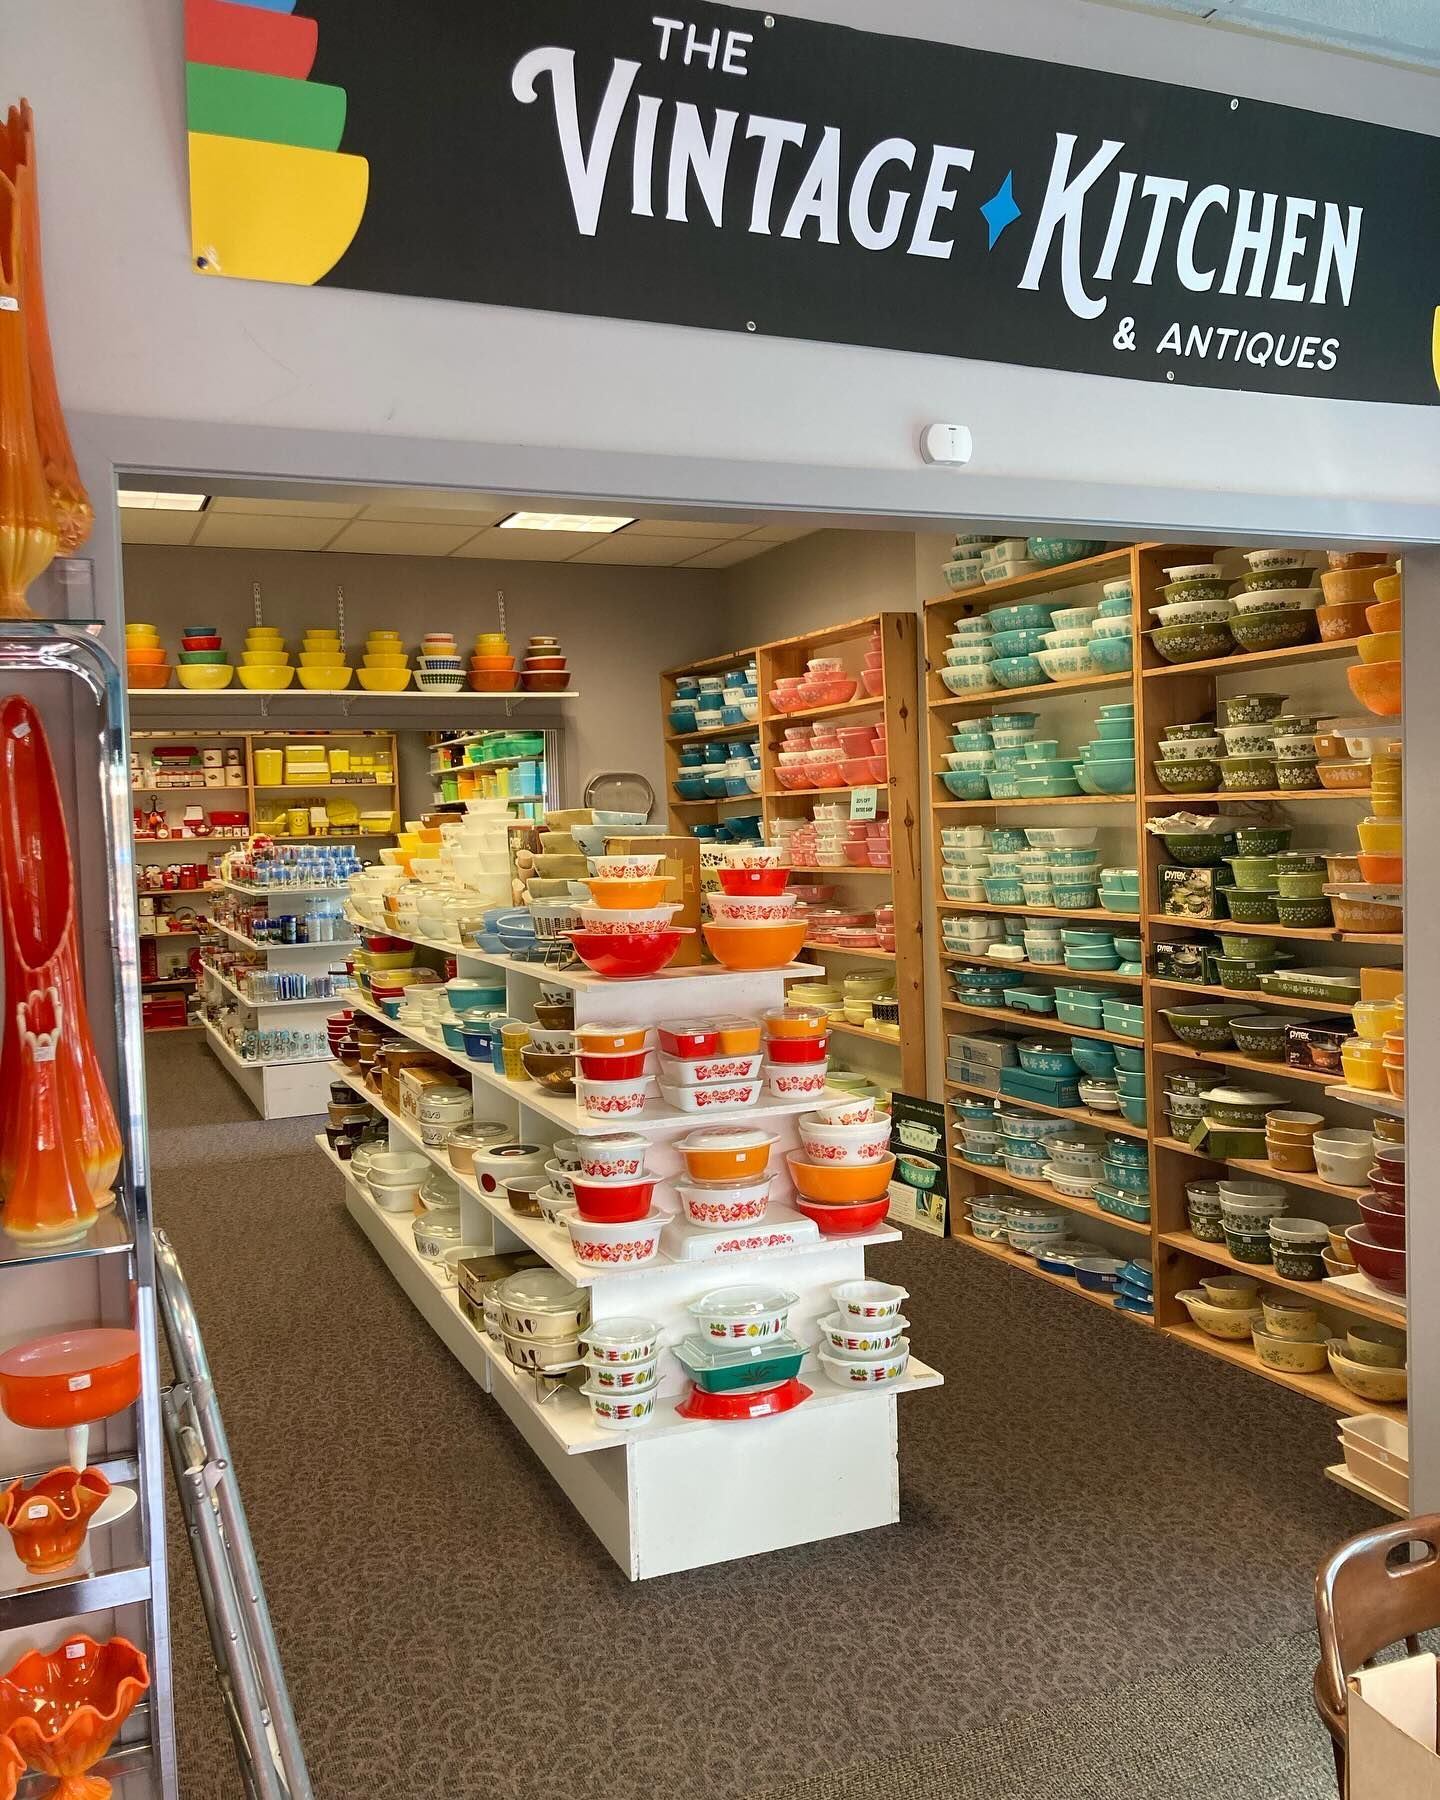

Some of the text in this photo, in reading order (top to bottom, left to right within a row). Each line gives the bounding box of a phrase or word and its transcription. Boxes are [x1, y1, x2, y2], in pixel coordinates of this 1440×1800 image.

[652, 16, 754, 76] THE
[511, 46, 1364, 320] VINTAGE KITCHEN
[1112, 316, 1340, 371] & ANTIQUES
